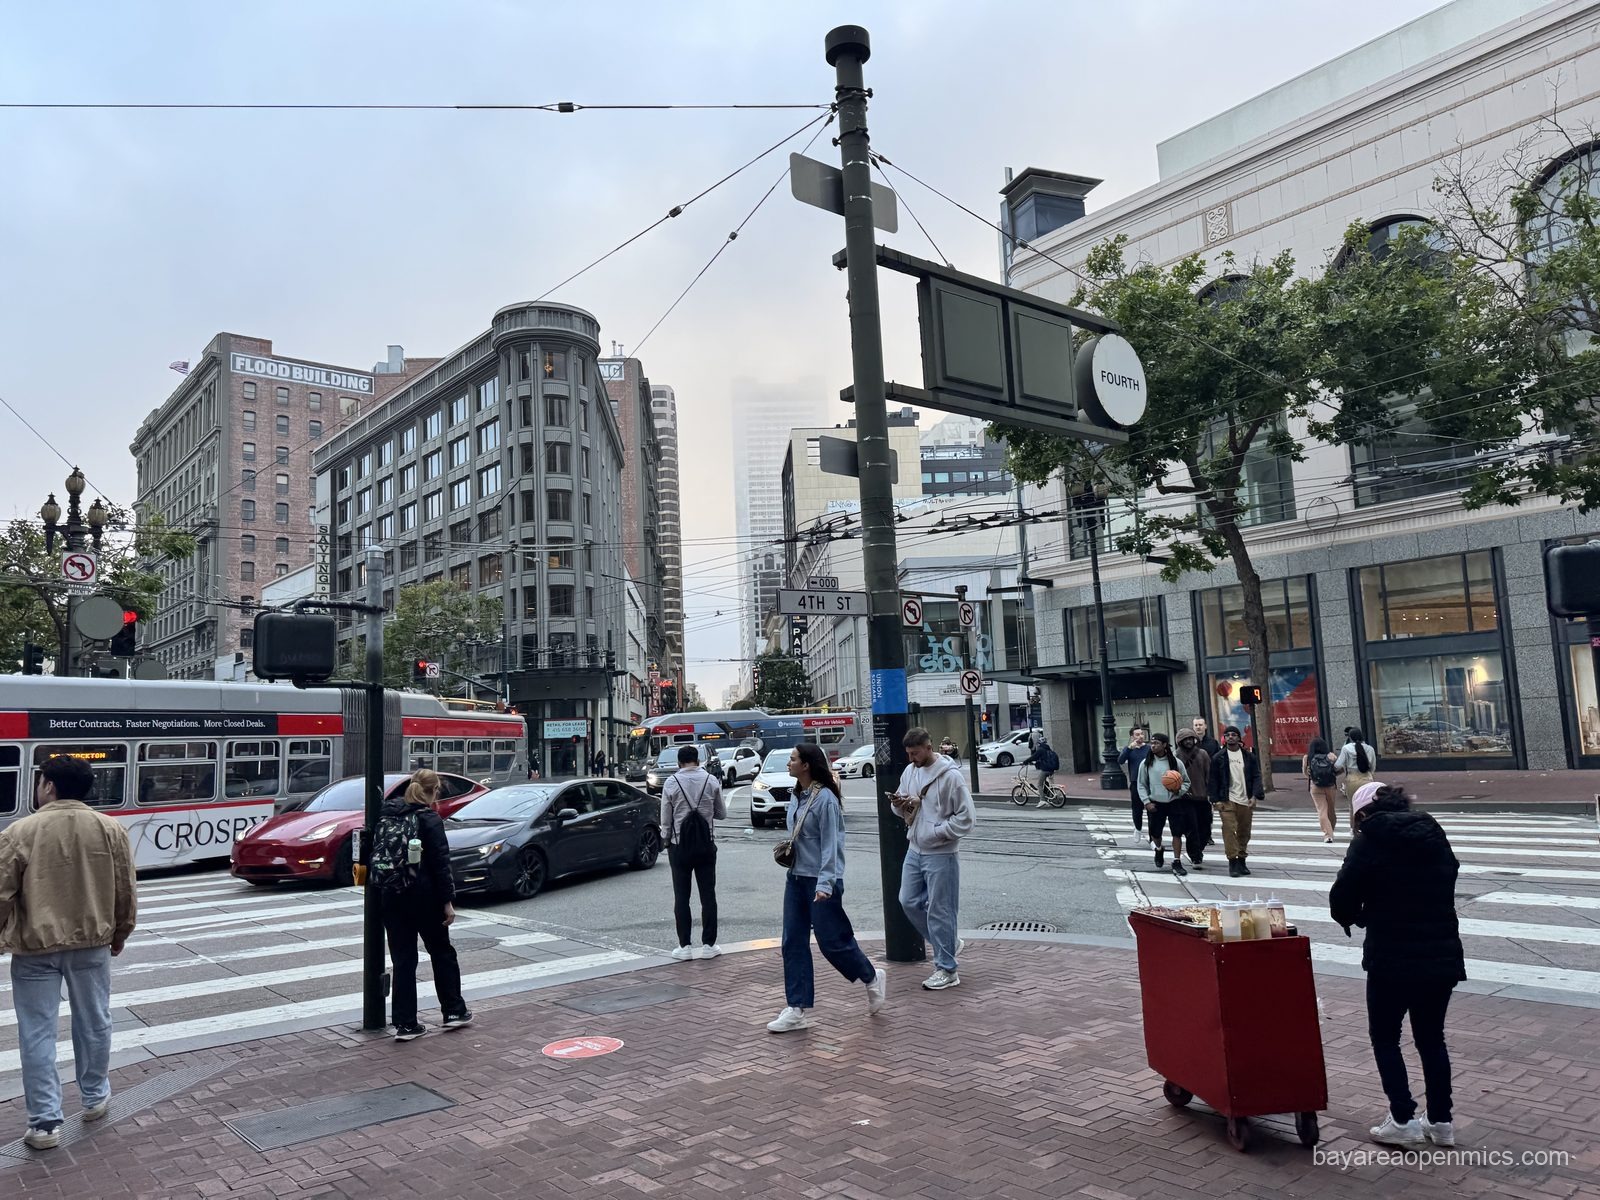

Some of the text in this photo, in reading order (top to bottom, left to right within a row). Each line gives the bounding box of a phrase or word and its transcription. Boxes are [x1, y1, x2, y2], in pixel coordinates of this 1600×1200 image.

[235, 356, 370, 391] FLOOD BUILDING
[1101, 370, 1140, 391] FOURTH
[819, 578, 837, 588] 000
[798, 595, 852, 611] 4TH ST
[1253, 689, 1261, 700] 9
[49, 719, 266, 729] Better Contracts. Faster Negotiations. More Closed Deals.
[1275, 716, 1318, 724] 415.773.3546
